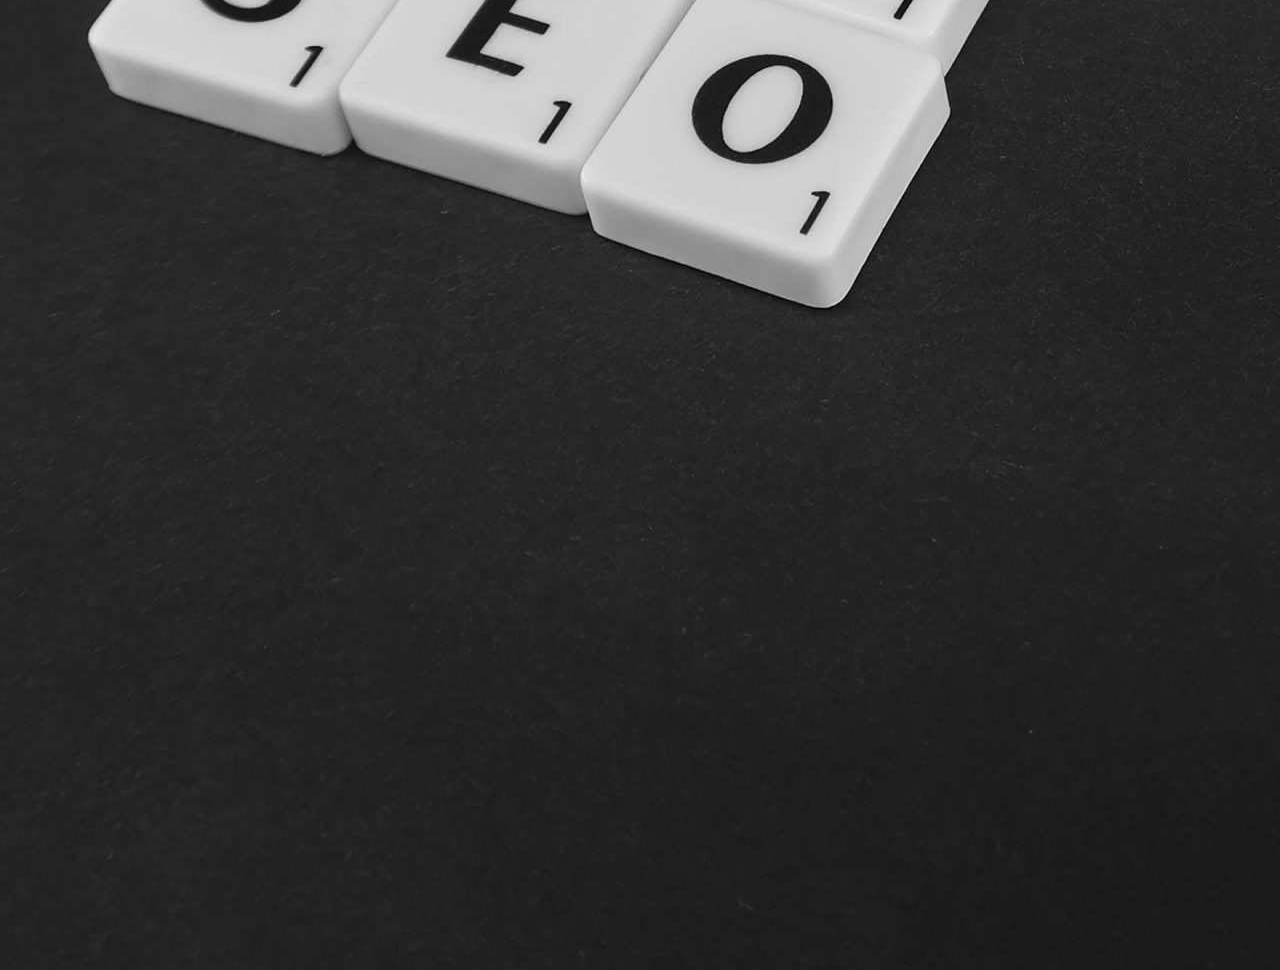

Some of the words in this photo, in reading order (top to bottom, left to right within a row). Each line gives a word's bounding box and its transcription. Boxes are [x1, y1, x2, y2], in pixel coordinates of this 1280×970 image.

[290, 46, 324, 87] 1
[538, 101, 572, 144] 1
[800, 191, 830, 235] 1
